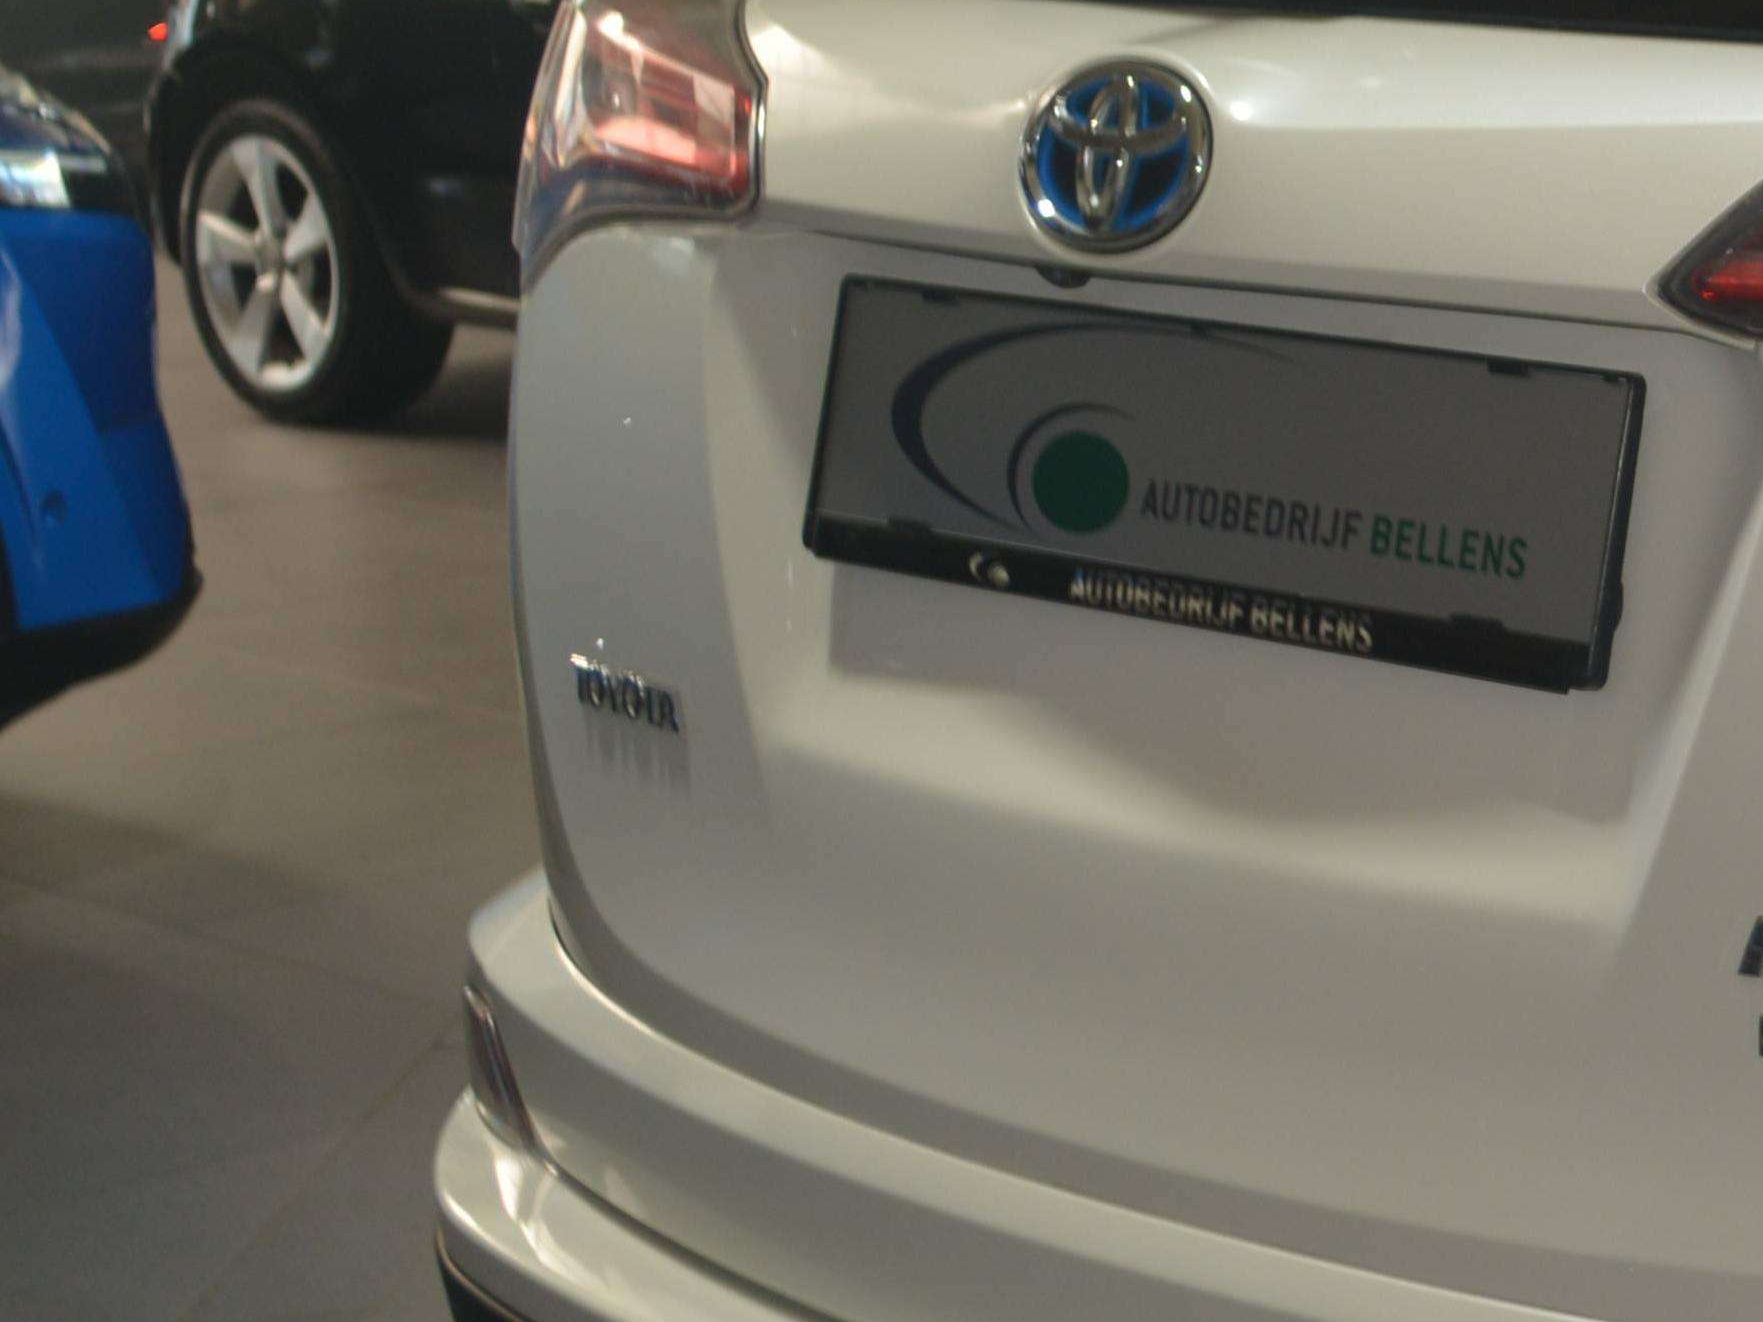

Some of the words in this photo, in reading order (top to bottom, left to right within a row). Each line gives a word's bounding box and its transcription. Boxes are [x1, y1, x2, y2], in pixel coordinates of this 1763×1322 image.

[1139, 479, 1363, 551] AUTOBEDRIJF
[1369, 513, 1529, 579] BELLENS
[1069, 568, 1246, 630] AUTOBEDRIJF
[1250, 593, 1373, 653] BELLENS
[571, 653, 683, 733] TOYOTA
